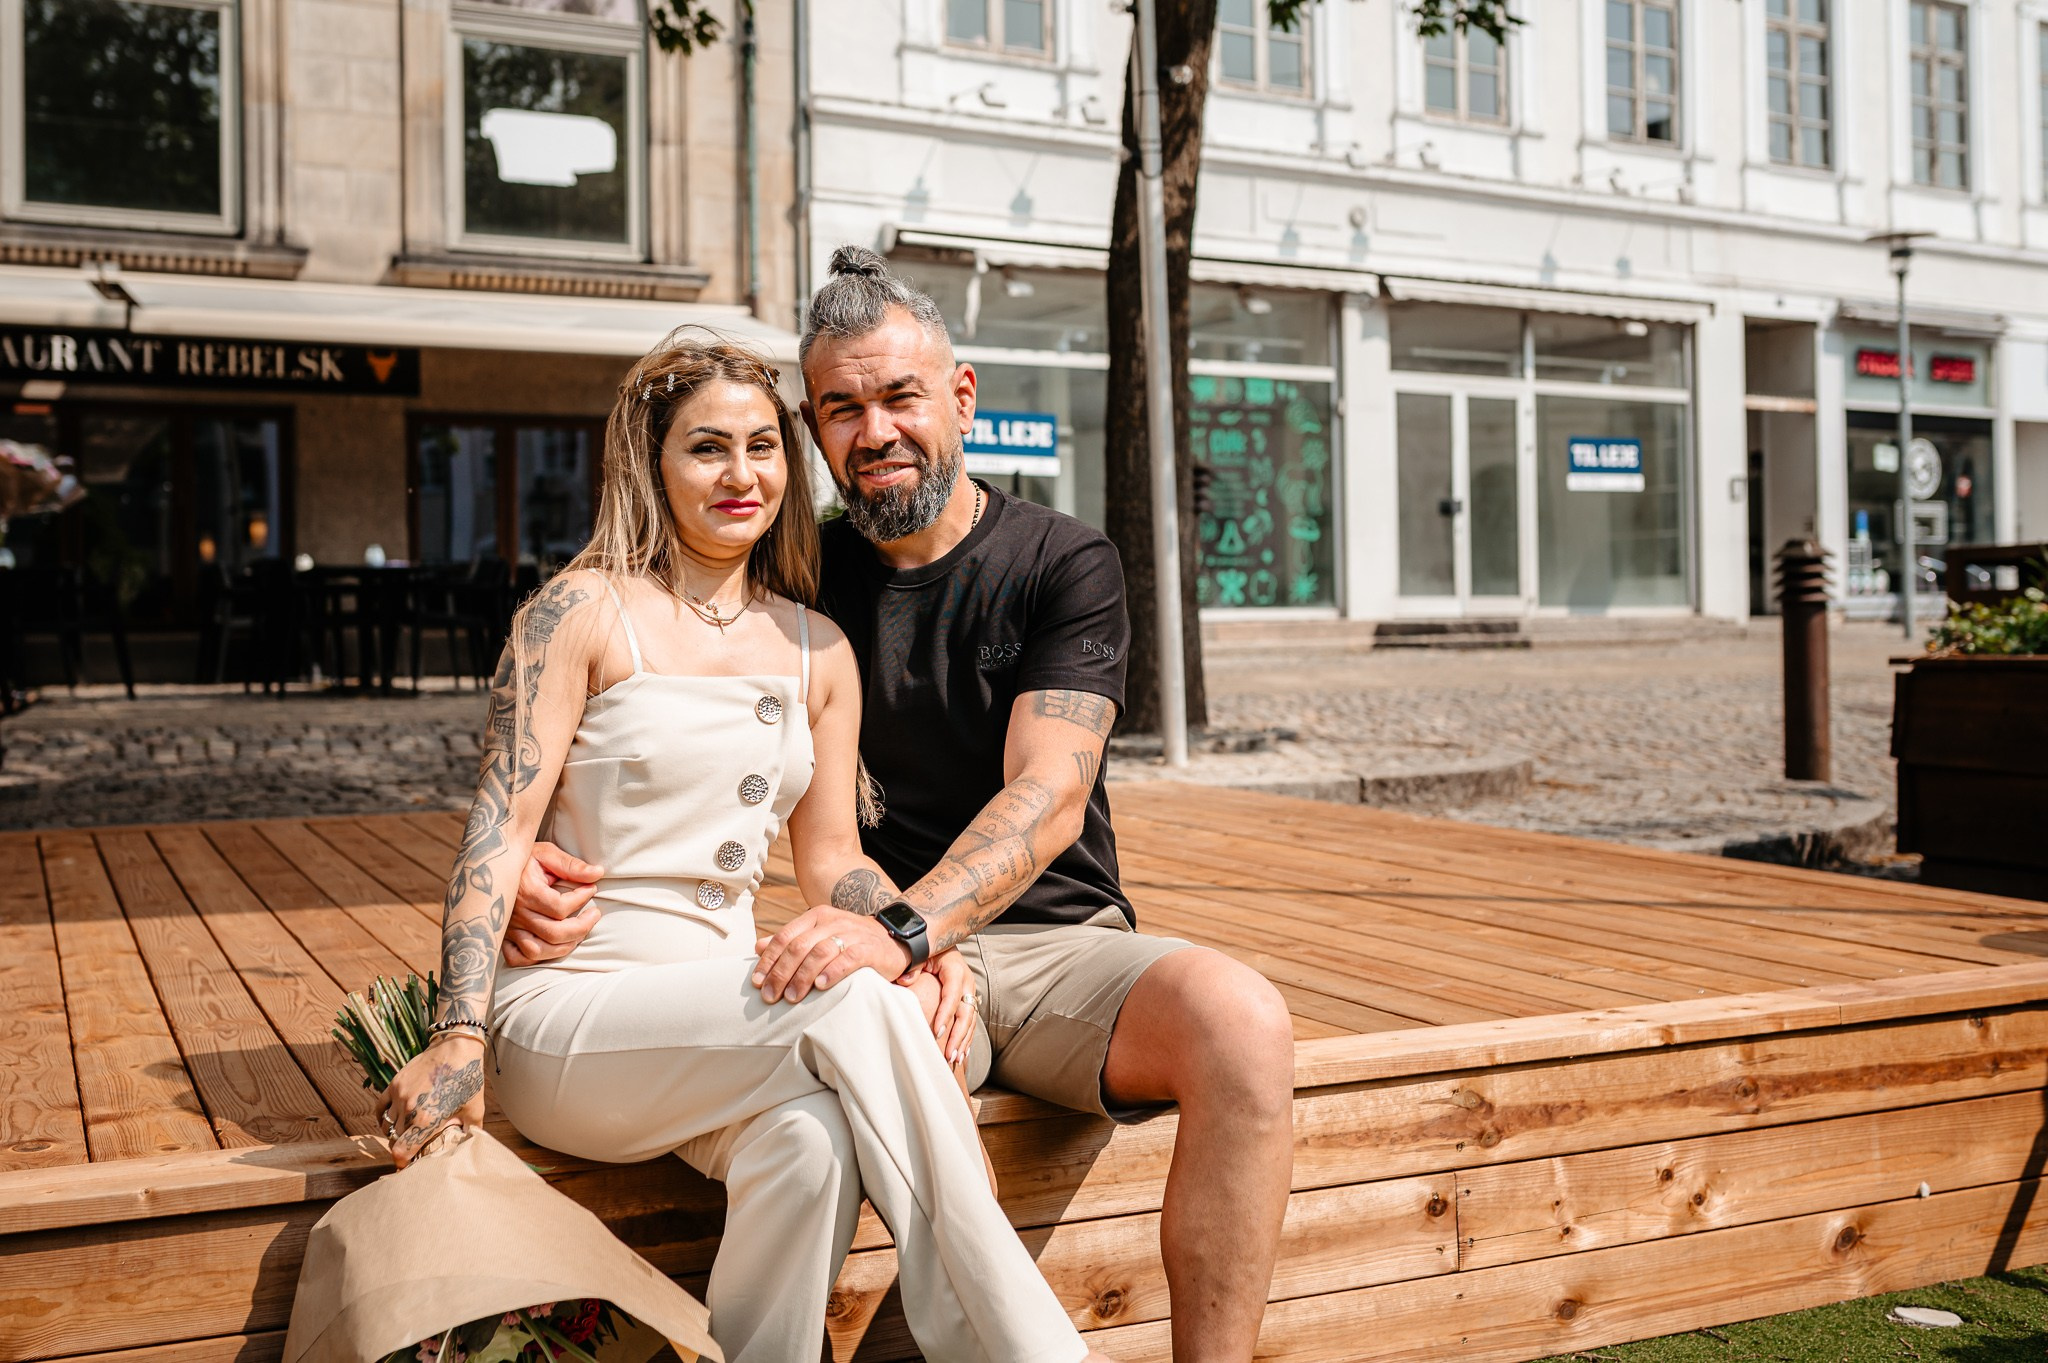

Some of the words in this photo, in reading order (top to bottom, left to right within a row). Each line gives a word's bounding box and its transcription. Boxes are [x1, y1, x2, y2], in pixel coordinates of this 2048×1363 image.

[178, 342, 344, 382] REBELSK
[998, 419, 1053, 449] LEJE
[977, 642, 1022, 660] BOSS
[1081, 639, 1115, 661] BOSS
[1004, 802, 1020, 813] 30
[997, 862, 1009, 877] 28
